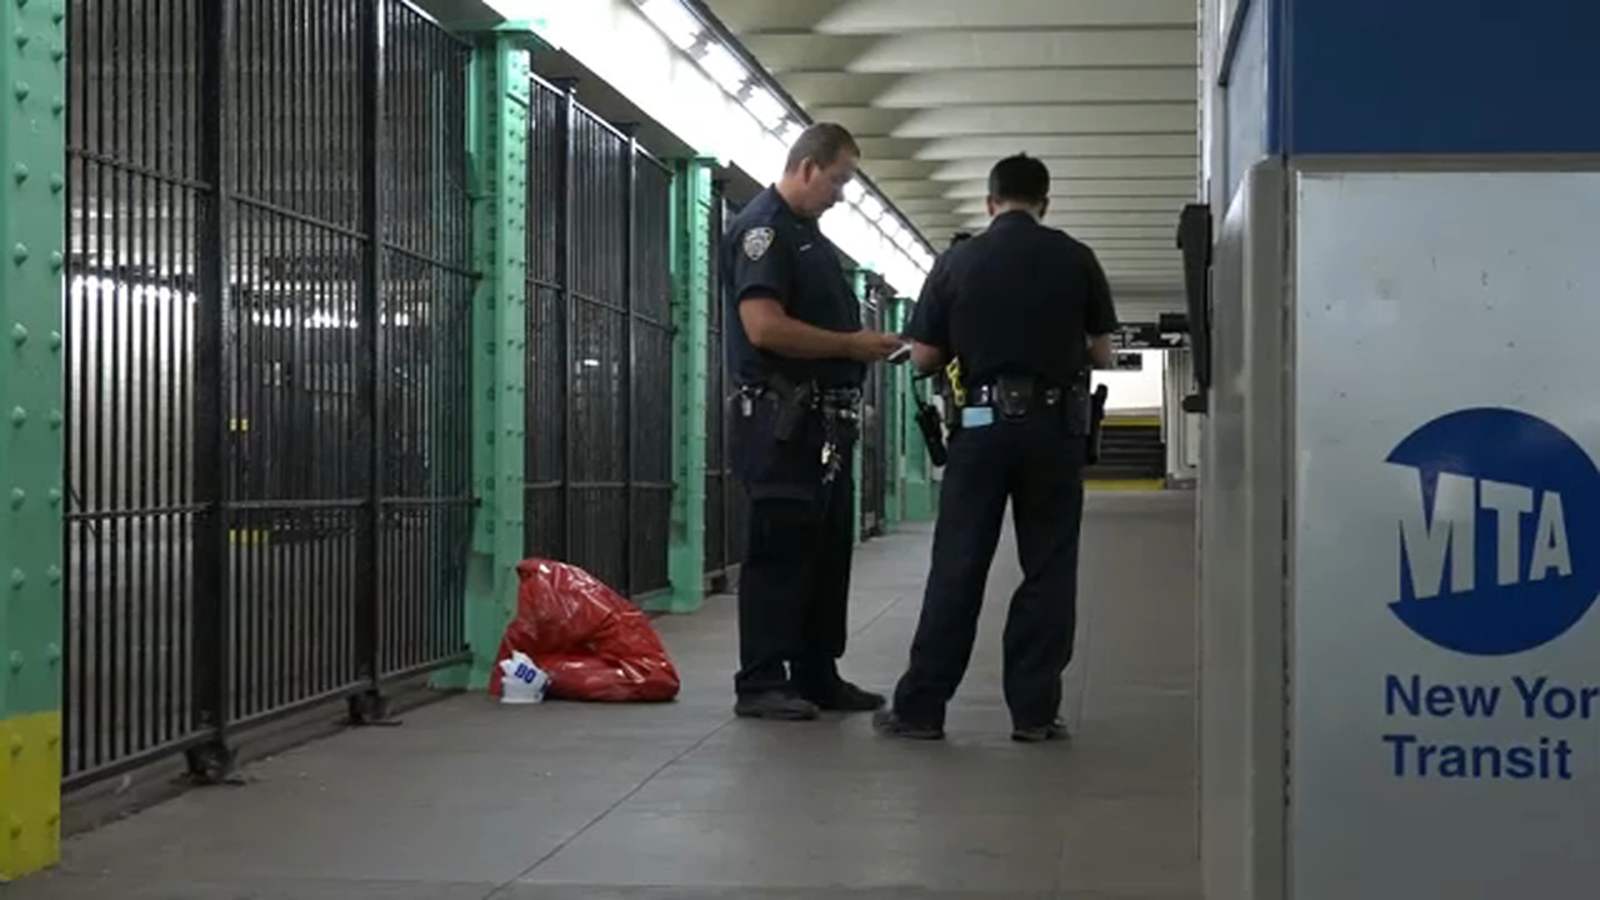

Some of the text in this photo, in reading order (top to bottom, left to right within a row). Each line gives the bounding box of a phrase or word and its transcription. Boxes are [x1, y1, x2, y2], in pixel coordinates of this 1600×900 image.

[1388, 461, 1573, 602] MTA
[1385, 674, 1600, 719] New Yor
[1382, 734, 1573, 780] Transit
